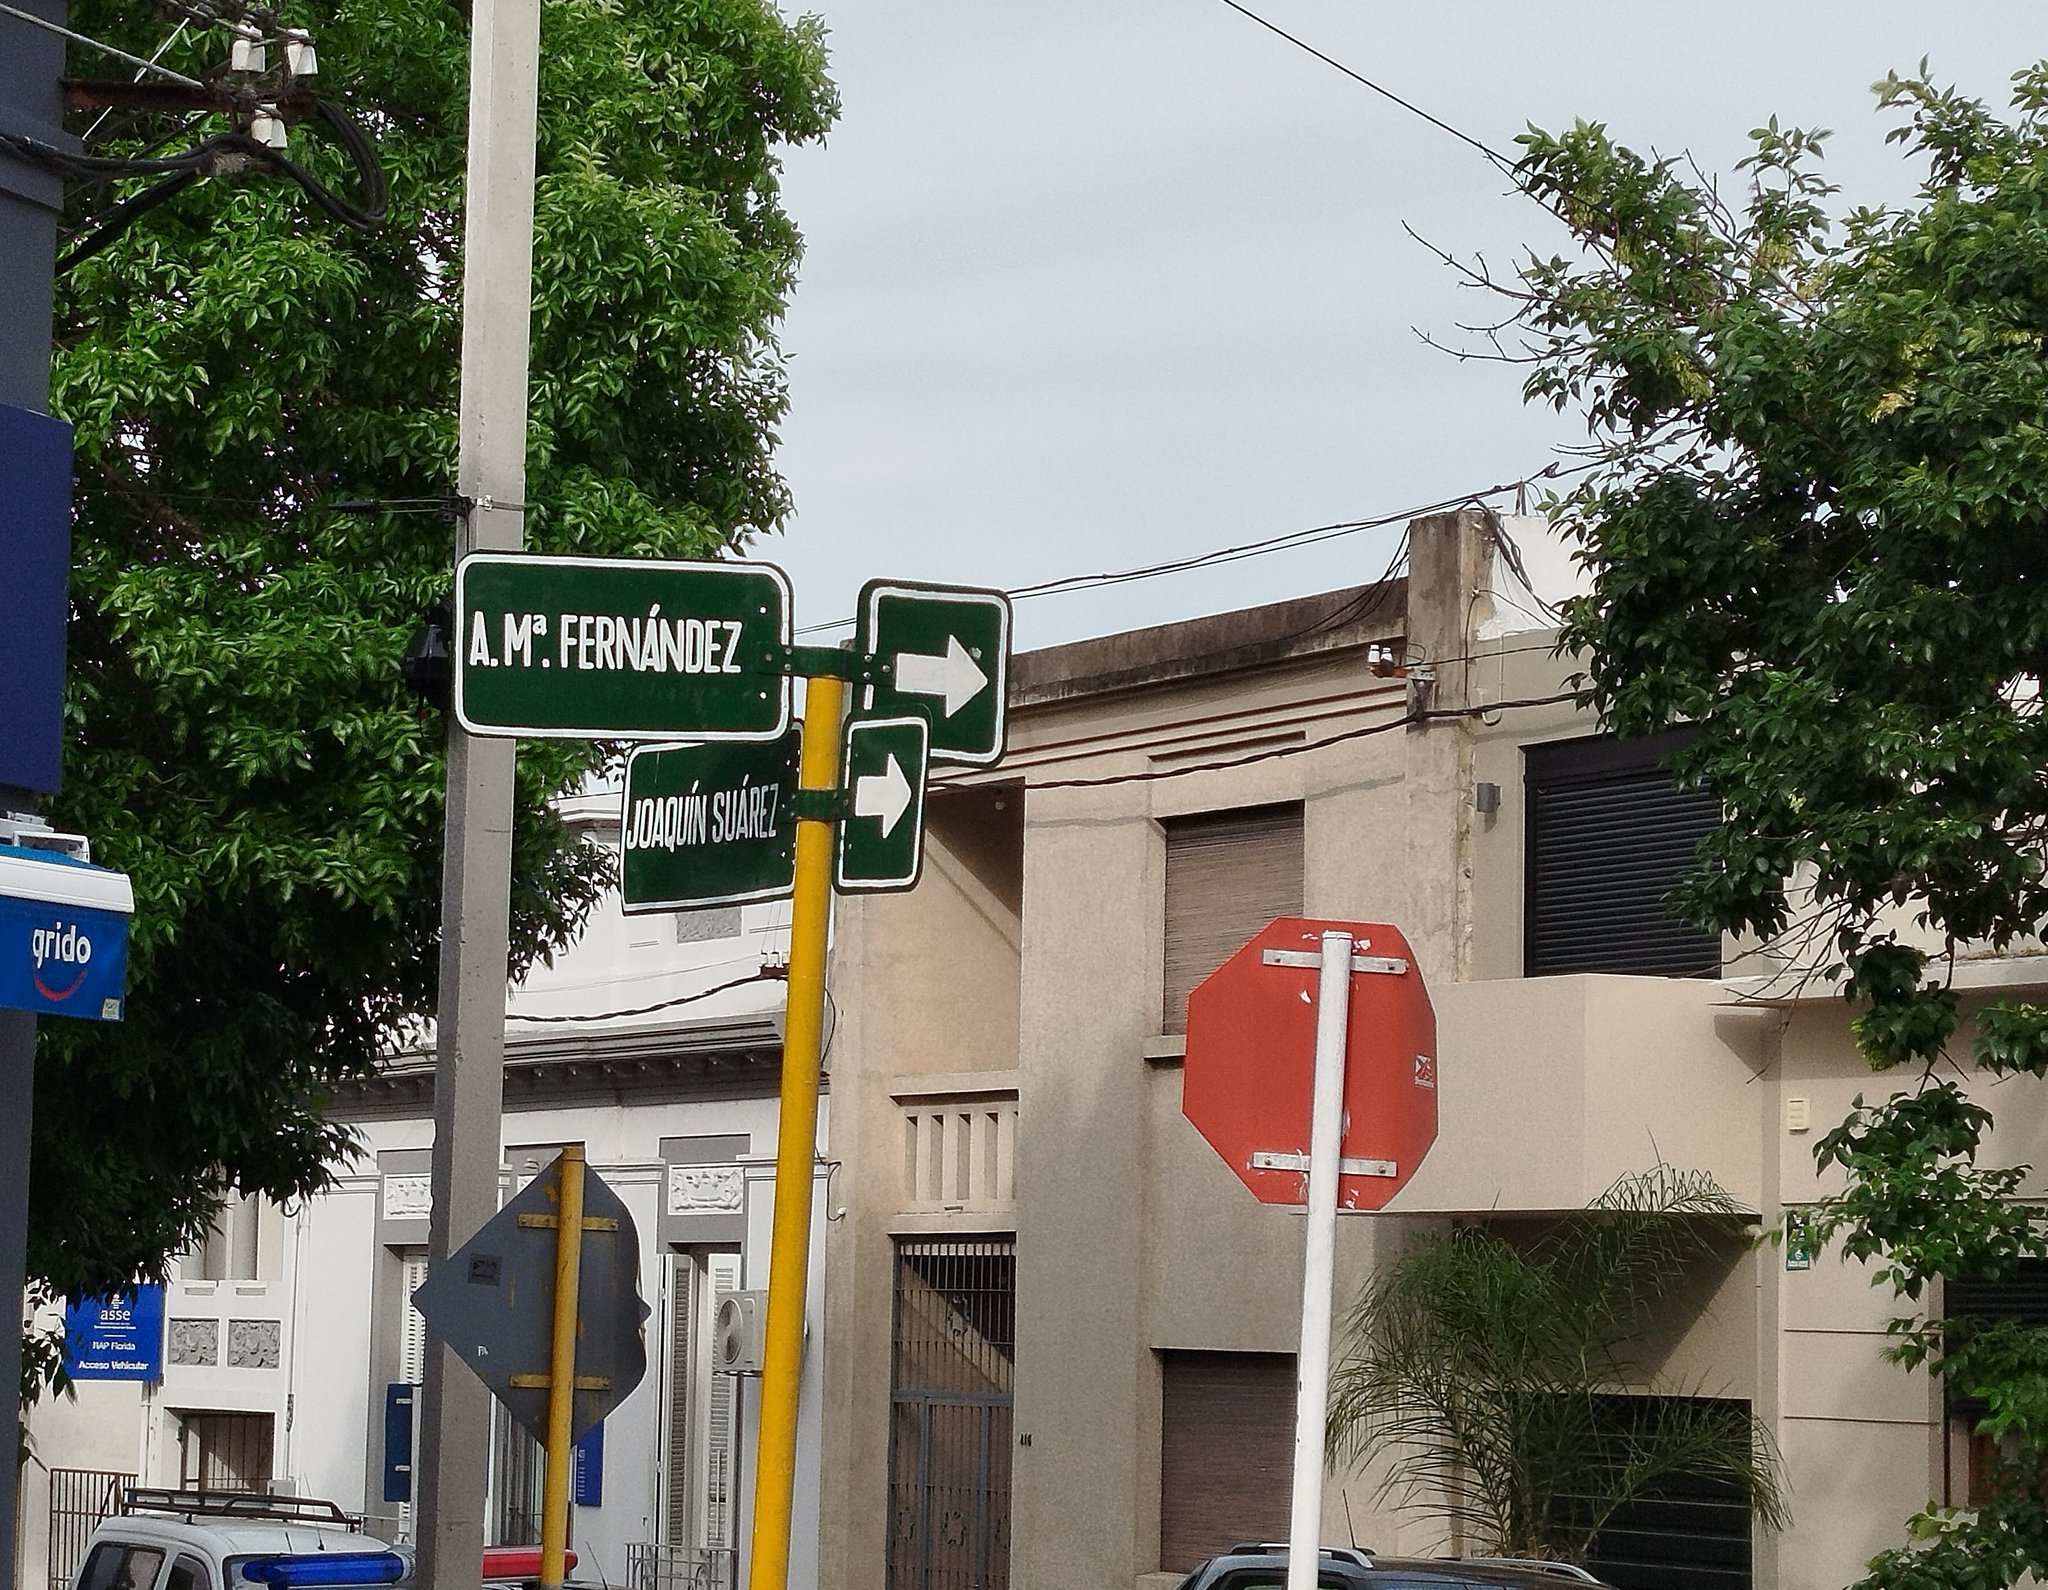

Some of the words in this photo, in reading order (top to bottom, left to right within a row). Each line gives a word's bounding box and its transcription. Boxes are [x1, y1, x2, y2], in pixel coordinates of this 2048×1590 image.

[560, 603, 743, 673] FERNÁNDEZ
[626, 779, 708, 853] JOAQUÍN
[711, 773, 779, 844] SUÁREZ
[32, 921, 92, 969] grido
[100, 1310, 131, 1321] asse
[78, 1360, 110, 1370] Acceso
[111, 1360, 149, 1370] Vehicular
